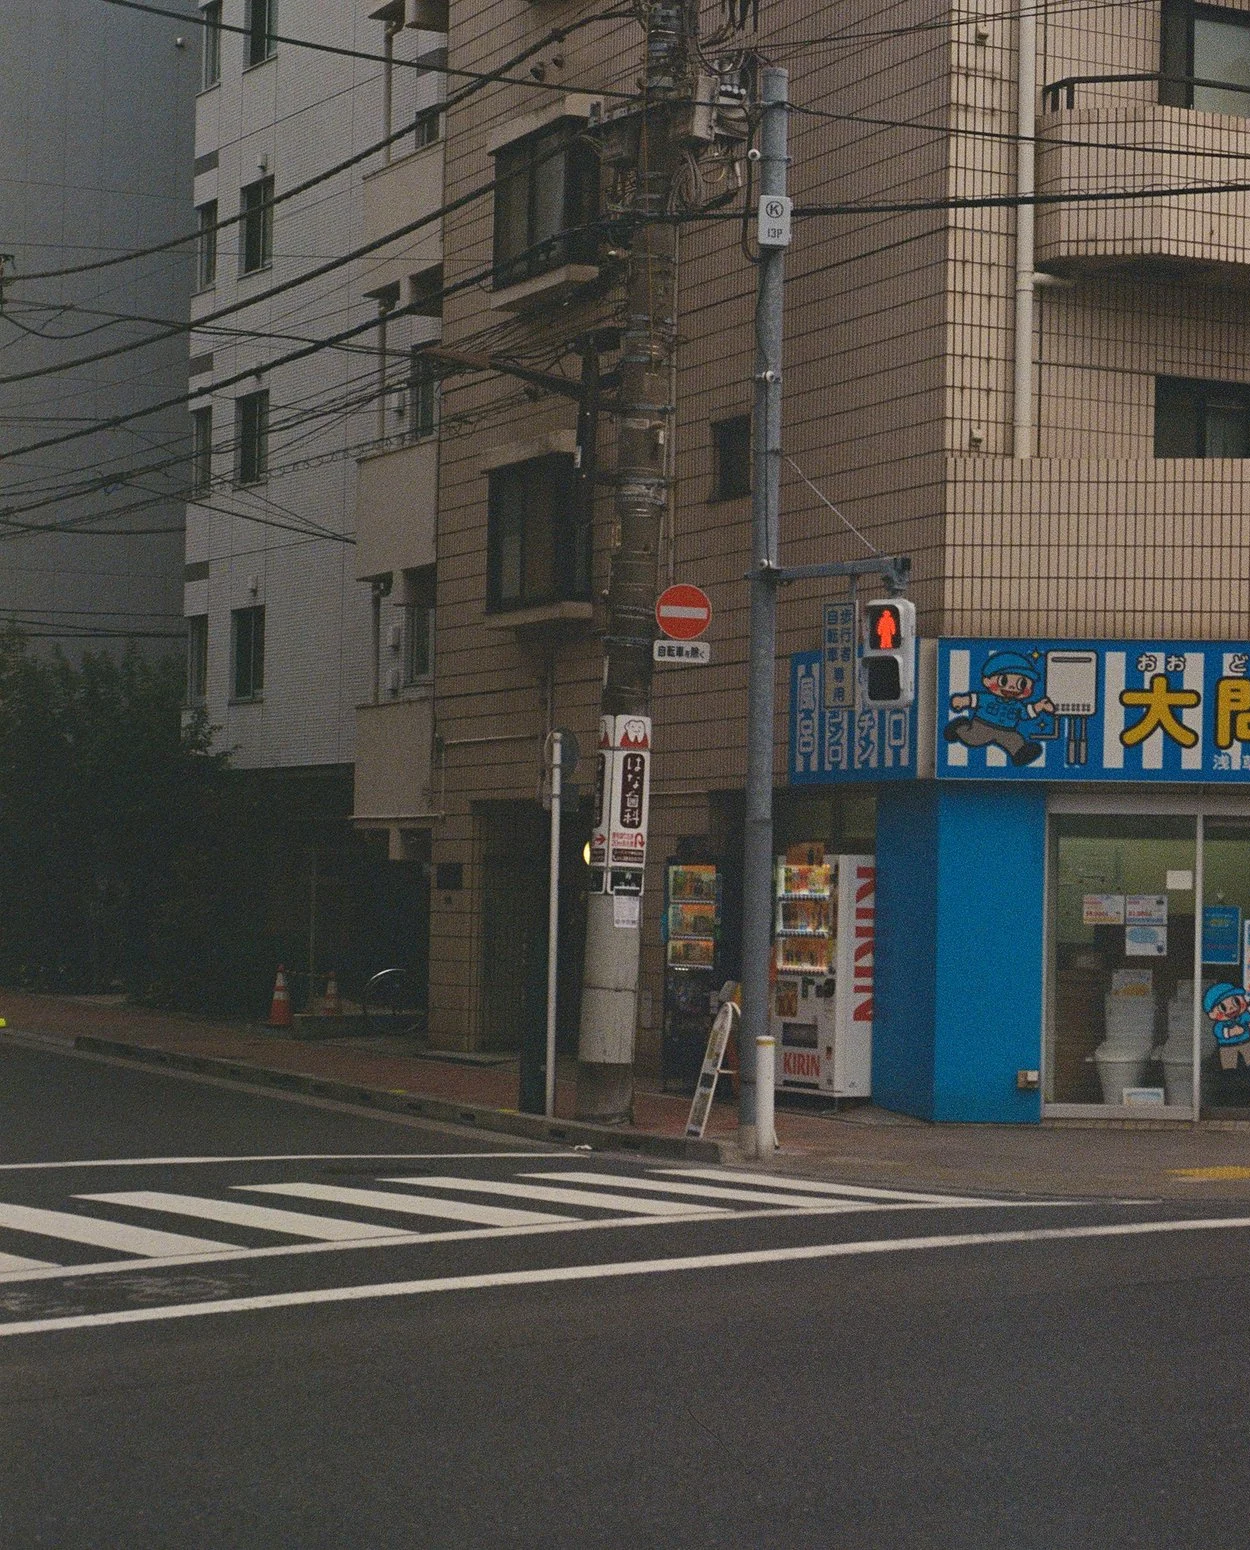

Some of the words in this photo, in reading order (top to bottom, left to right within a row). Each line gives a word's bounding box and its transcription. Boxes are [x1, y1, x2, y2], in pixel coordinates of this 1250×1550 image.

[767, 228, 783, 239] 13P
[658, 645, 705, 660] 自転車を除く
[622, 756, 643, 826] はな歯科
[783, 1051, 822, 1077] KIRIN
